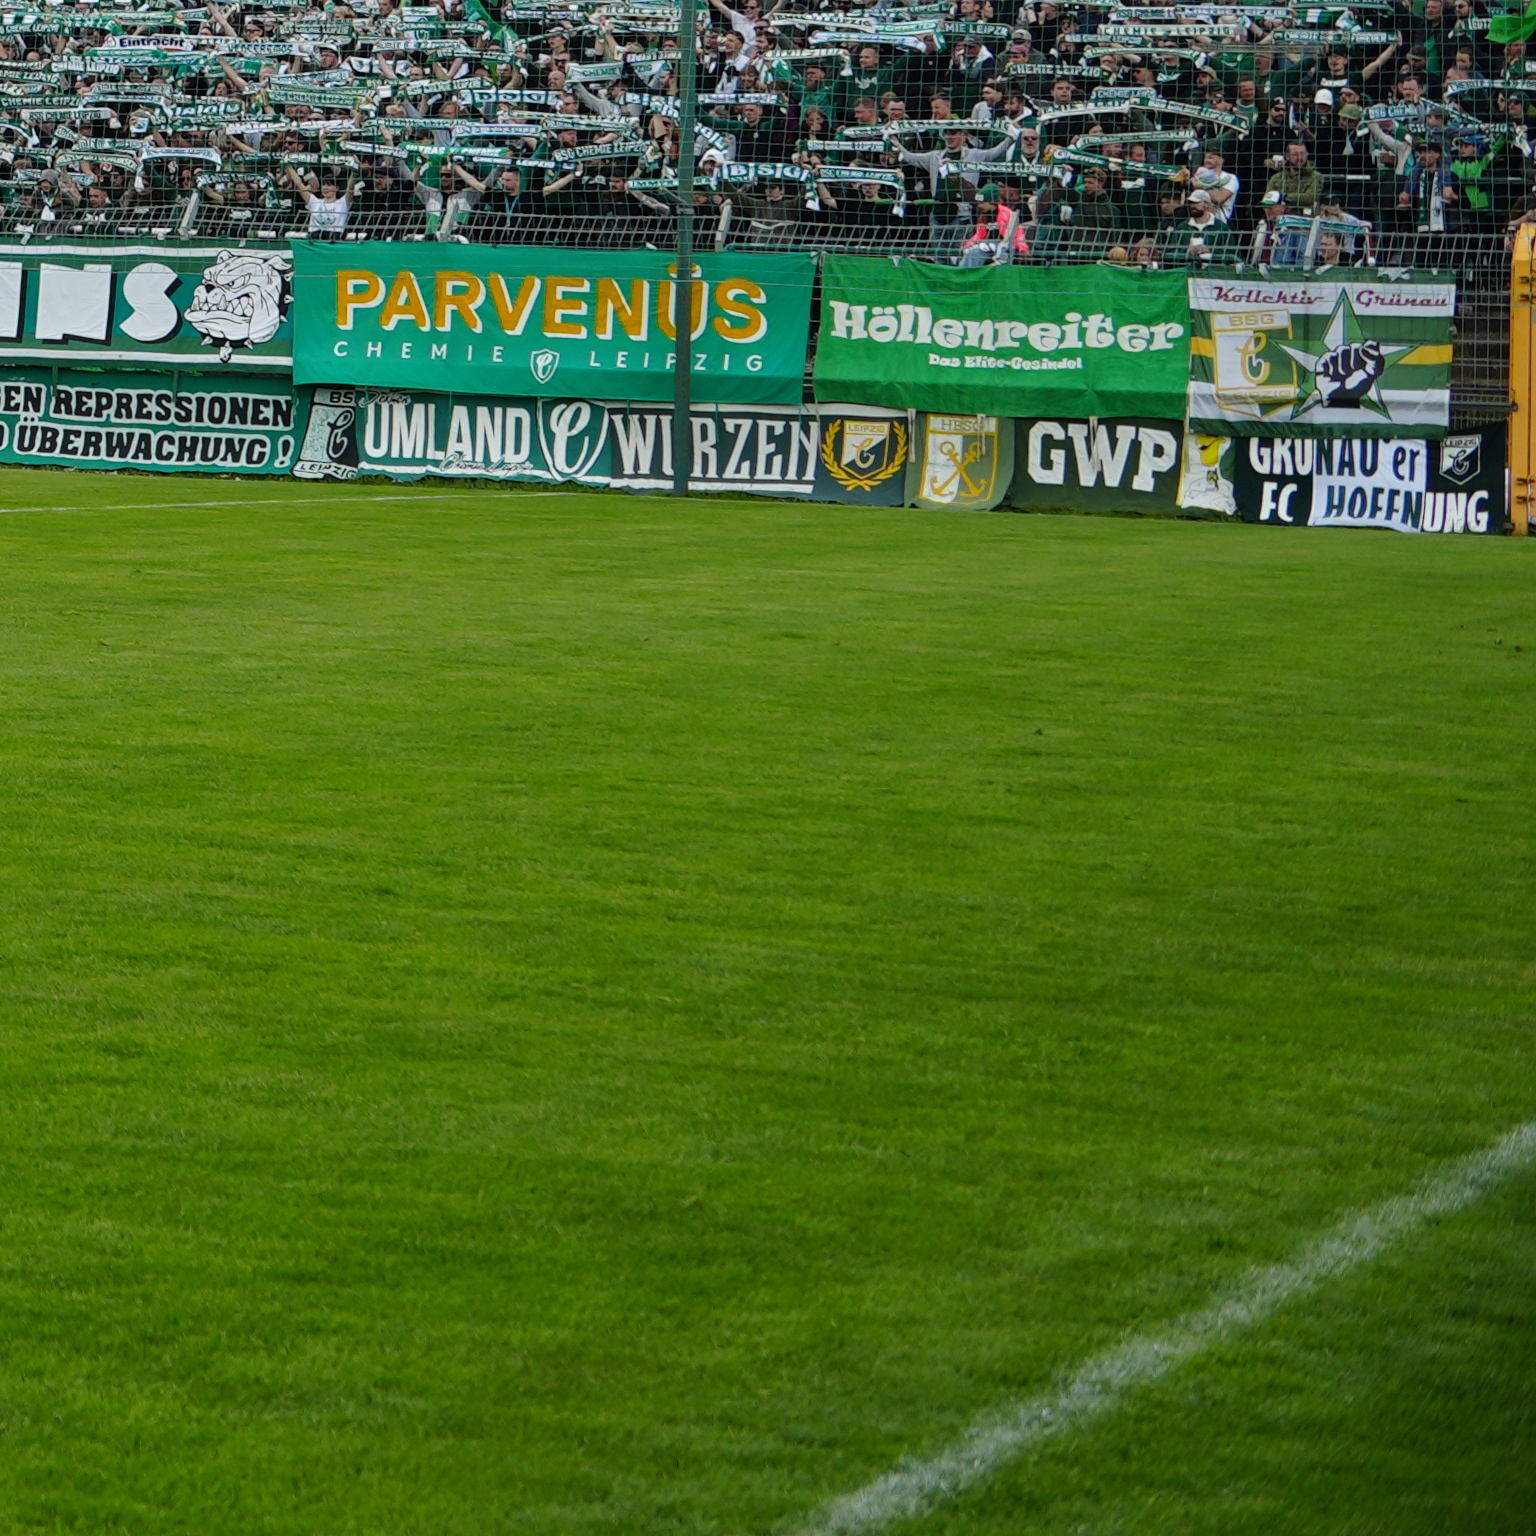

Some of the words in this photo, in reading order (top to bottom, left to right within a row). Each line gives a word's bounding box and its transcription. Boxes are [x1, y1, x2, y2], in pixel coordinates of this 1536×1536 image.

[119, 37, 185, 52] Eintracht
[1009, 64, 1054, 76] CHEMIE
[576, 145, 613, 159] CHEMIE
[335, 263, 768, 343] PARVENÜS
[1355, 289, 1449, 308] Grünau
[829, 300, 1185, 353] Höllenreiter
[1228, 314, 1276, 327] BSG
[333, 340, 504, 364] CHEMIE
[589, 350, 763, 372] LEIPZIG
[928, 352, 959, 367] Das
[962, 353, 1083, 371] Elite-Gesindel
[51, 384, 294, 430] REPRESSIONEN
[16, 414, 271, 468] ÜBERWACHUNG
[363, 401, 531, 463] UMLAND
[847, 424, 887, 435] LEIPZIG
[1027, 420, 1178, 493] GWP
[1259, 480, 1299, 523] FC
[1323, 484, 1490, 535] HOFFNUNG
